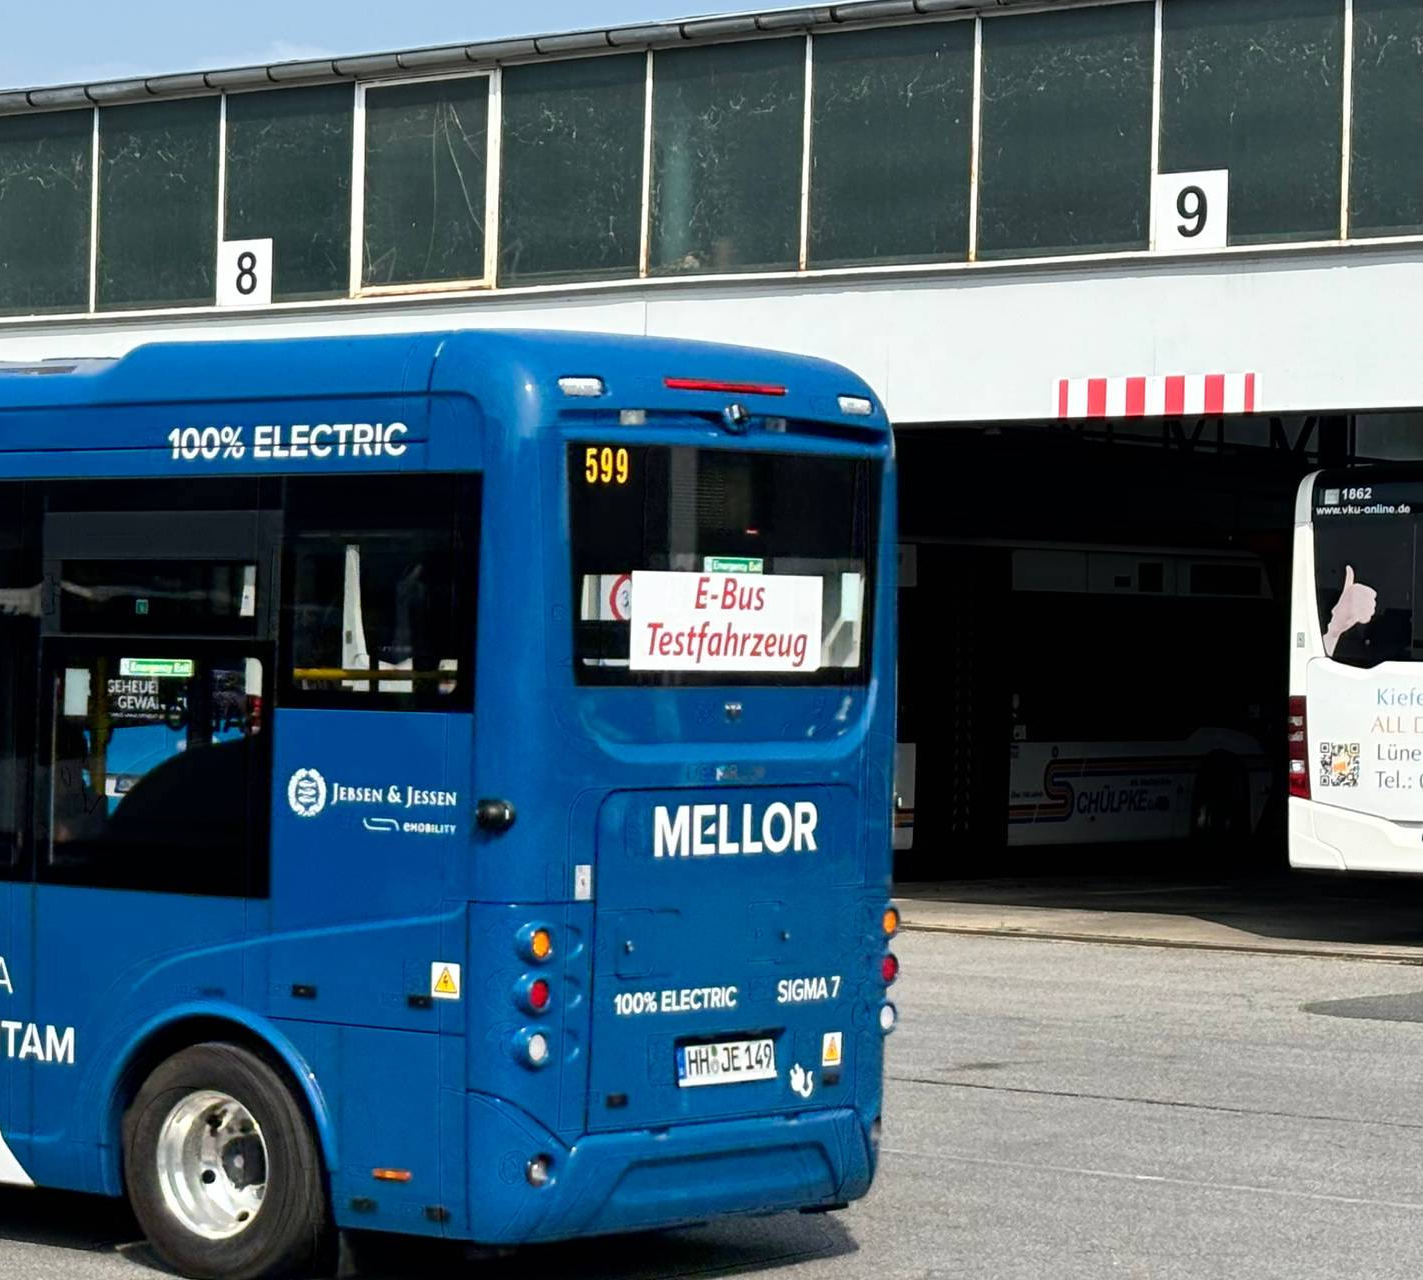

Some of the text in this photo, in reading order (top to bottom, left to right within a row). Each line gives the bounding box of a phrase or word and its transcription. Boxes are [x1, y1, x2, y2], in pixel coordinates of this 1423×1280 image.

[1176, 185, 1208, 238] 9
[235, 251, 258, 296] 8
[167, 422, 408, 461] 100% ELECTRIC
[585, 447, 629, 484] 599
[1315, 504, 1411, 516] www.vku-online.de
[1341, 487, 1373, 501] 1862
[694, 576, 766, 611] E-Bus
[647, 620, 808, 668] Testfahrzeug
[1370, 715, 1407, 734] ALL
[331, 782, 458, 809] JEBSEN & JESSEN
[1376, 770, 1413, 790] Tel.:
[653, 801, 819, 858] MELLOR
[613, 985, 739, 1016] 100% ELECTRIC
[777, 975, 842, 1004] SIGMA 7
[687, 1043, 773, 1076] HH JE 149
